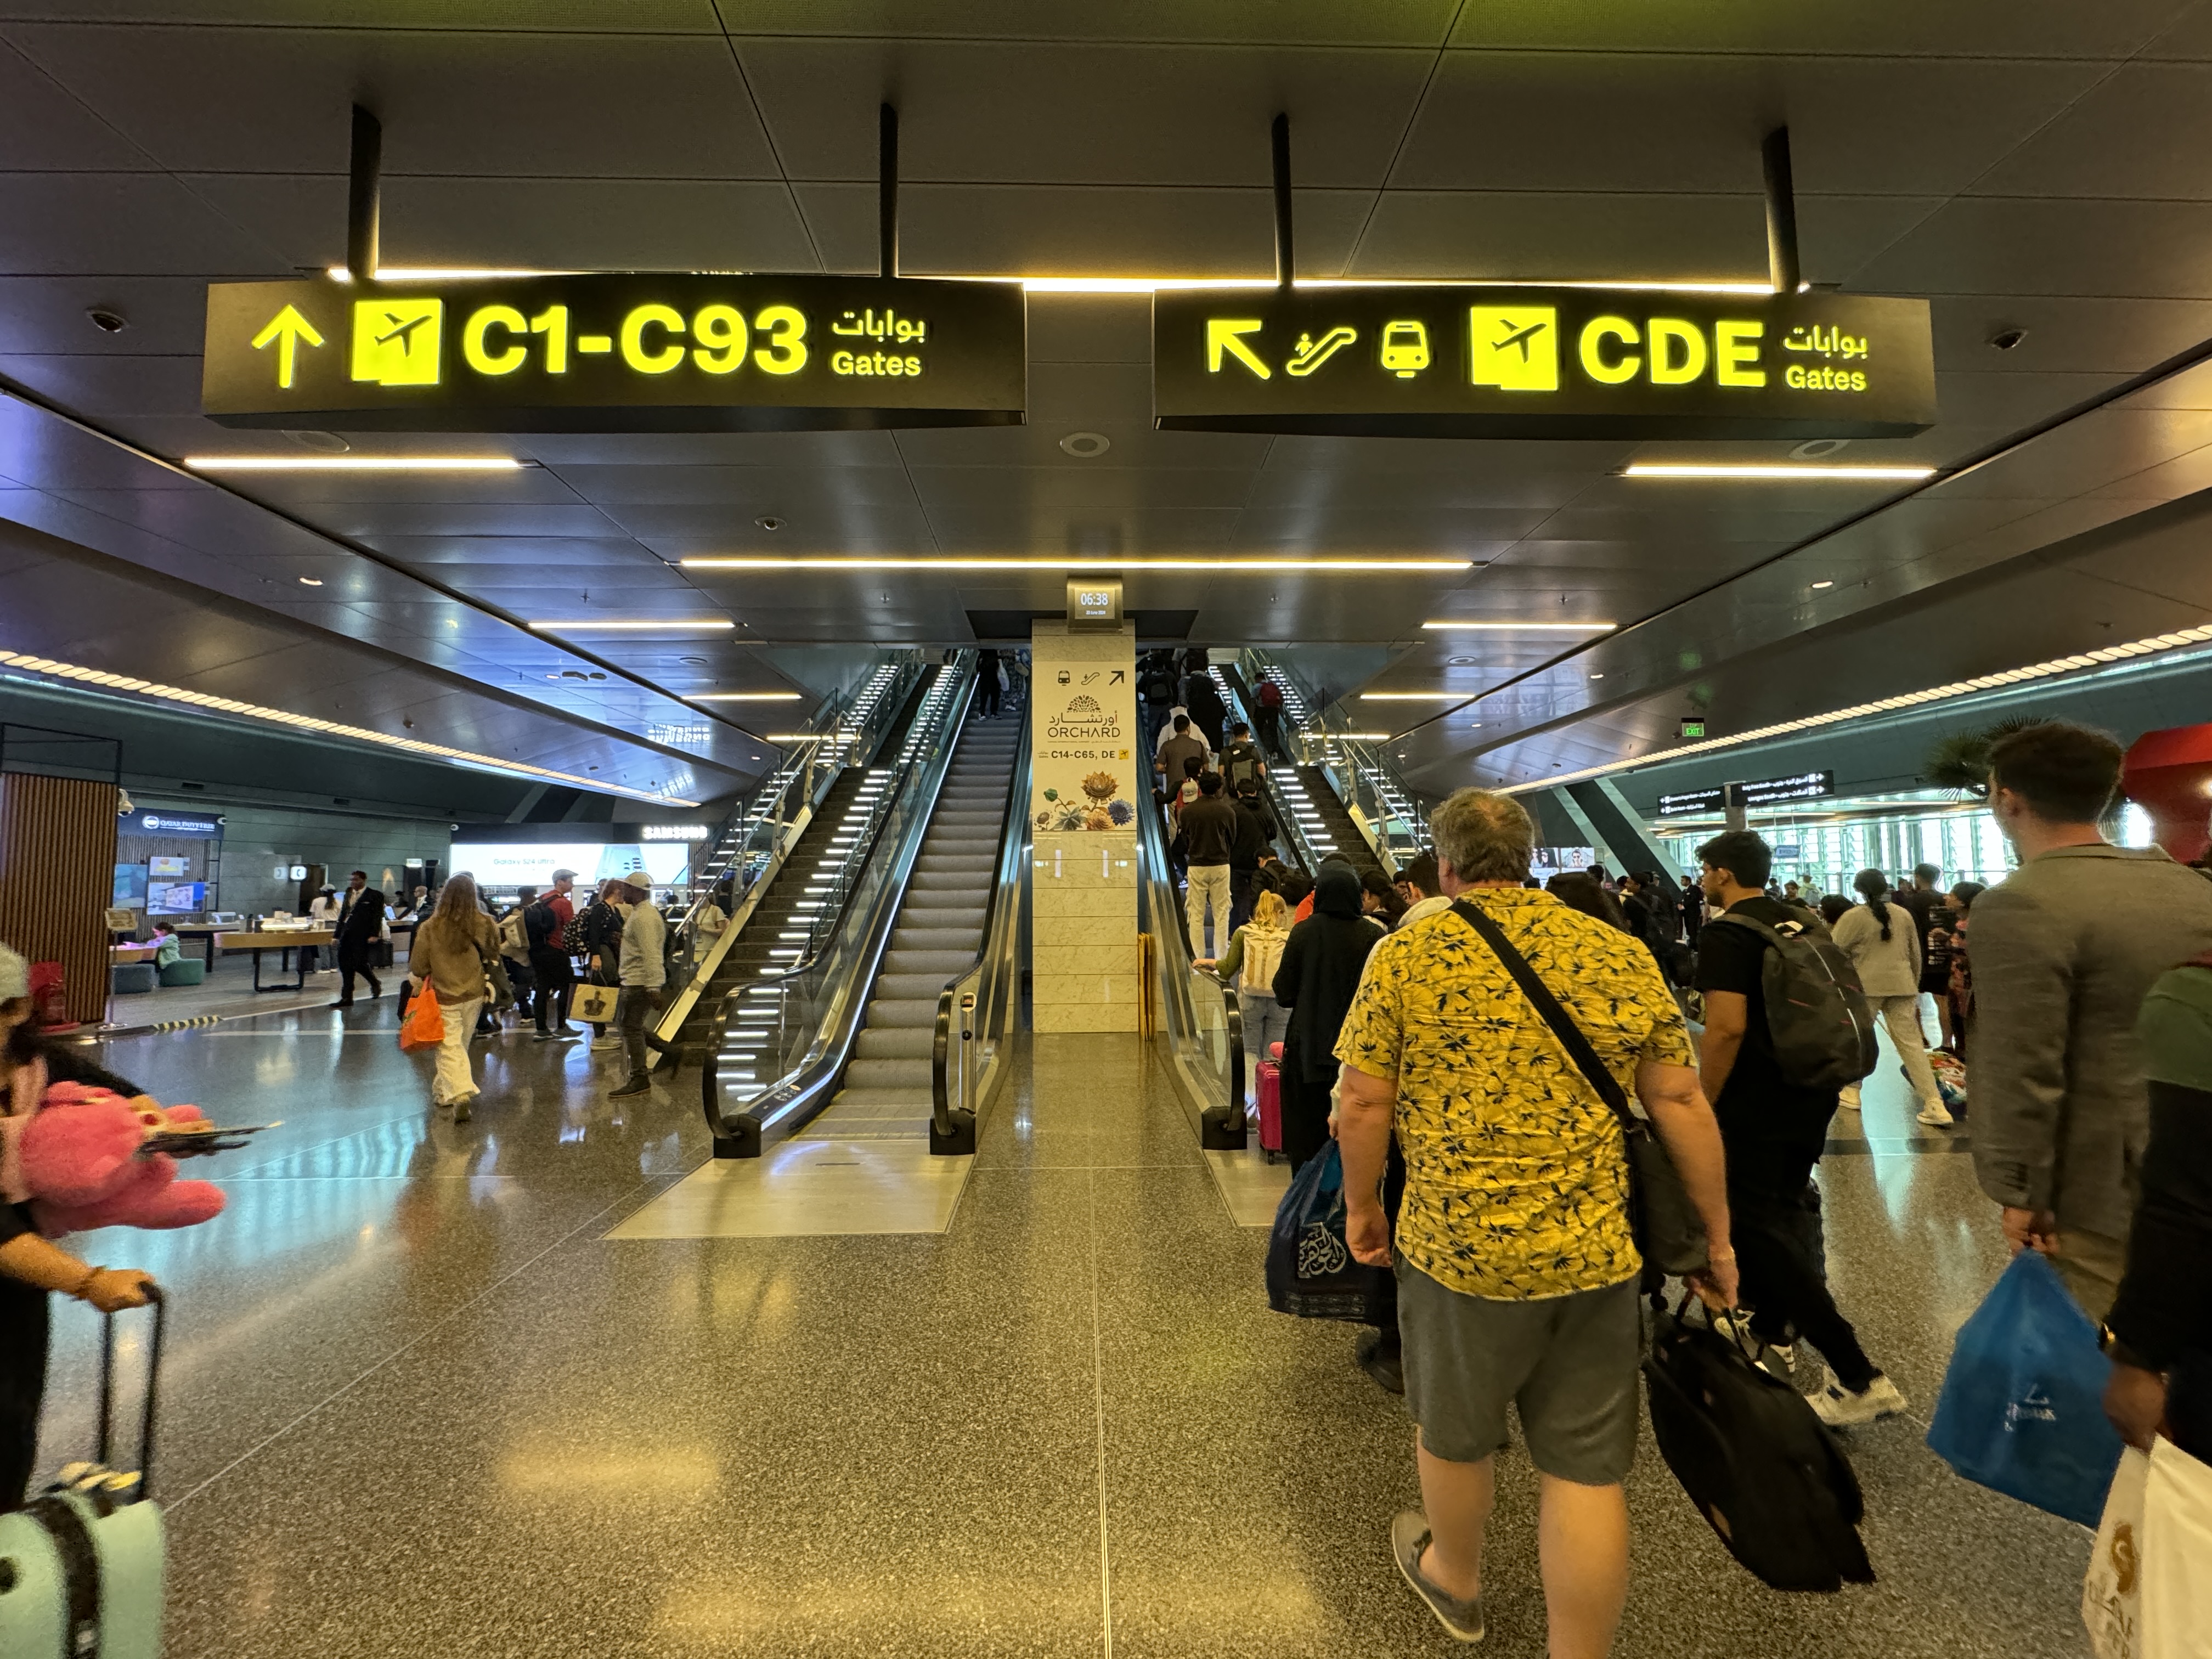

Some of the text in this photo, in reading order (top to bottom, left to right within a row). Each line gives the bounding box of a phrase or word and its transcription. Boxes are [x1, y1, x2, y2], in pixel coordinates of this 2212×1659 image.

[832, 309, 926, 343] بوابات
[462, 304, 809, 377] C1-C93
[1578, 315, 1767, 388] CDE
[1783, 325, 1868, 360] بوابات
[831, 351, 922, 376] Gates
[1786, 365, 1867, 391] Gates
[1080, 592, 1108, 606] 06:38
[1048, 727, 1120, 738] ORCHARD
[1051, 751, 1115, 760] C14-C65, DE
